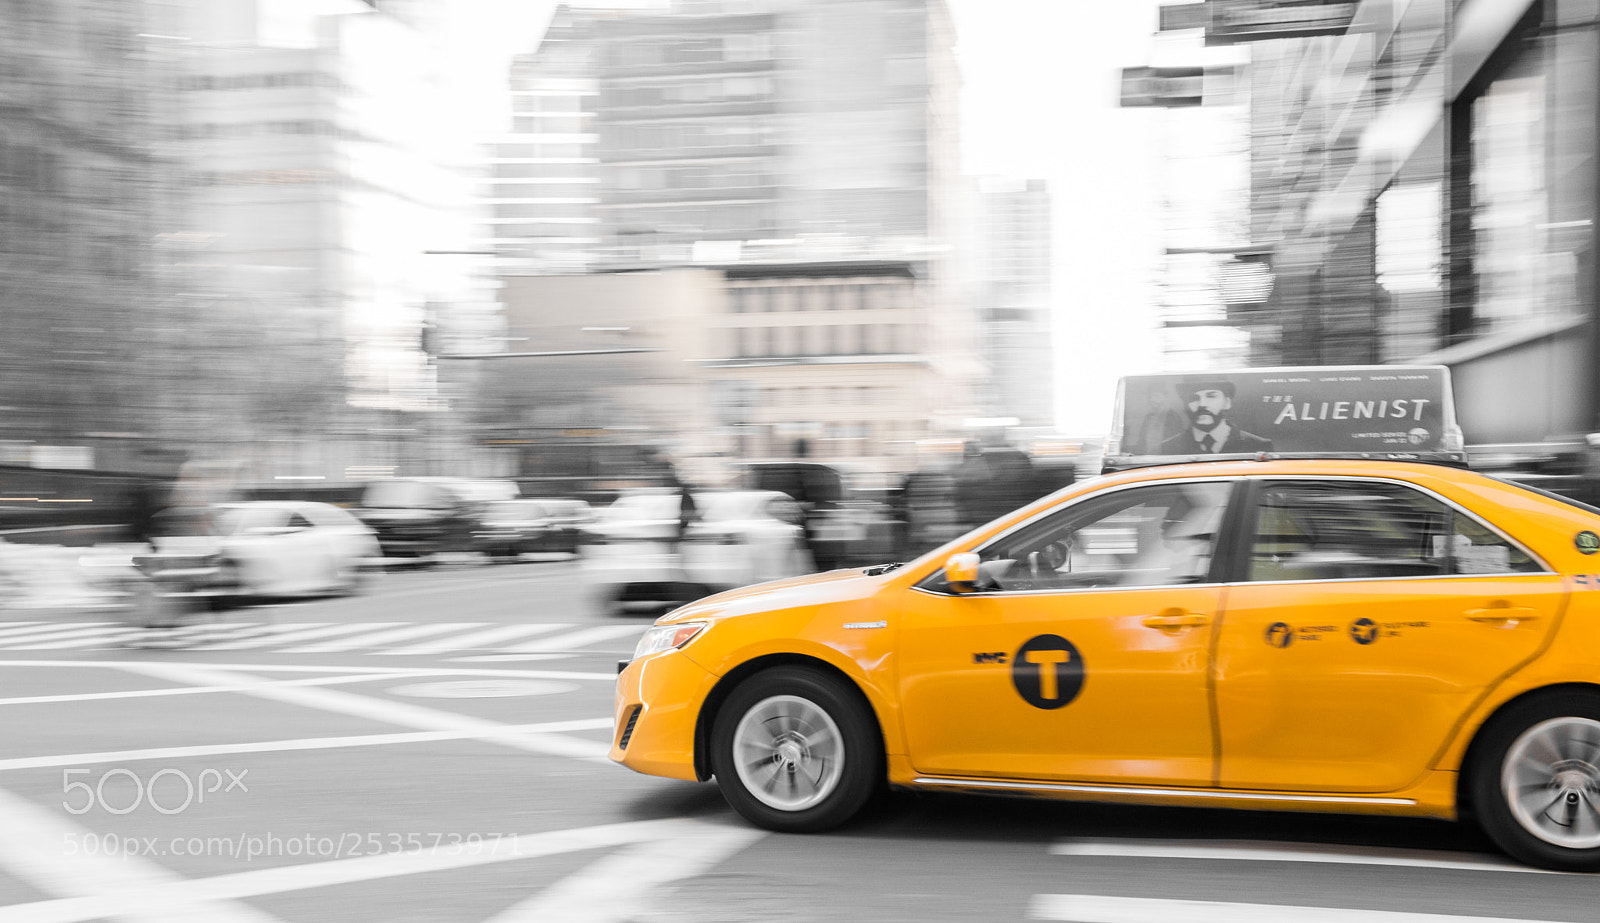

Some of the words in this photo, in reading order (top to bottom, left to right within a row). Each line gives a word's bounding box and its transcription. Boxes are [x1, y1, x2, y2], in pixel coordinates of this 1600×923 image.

[1262, 395, 1294, 403] THE
[1274, 399, 1430, 425] ALIENIST
[973, 652, 1006, 664] NYC
[1024, 649, 1072, 700] T
